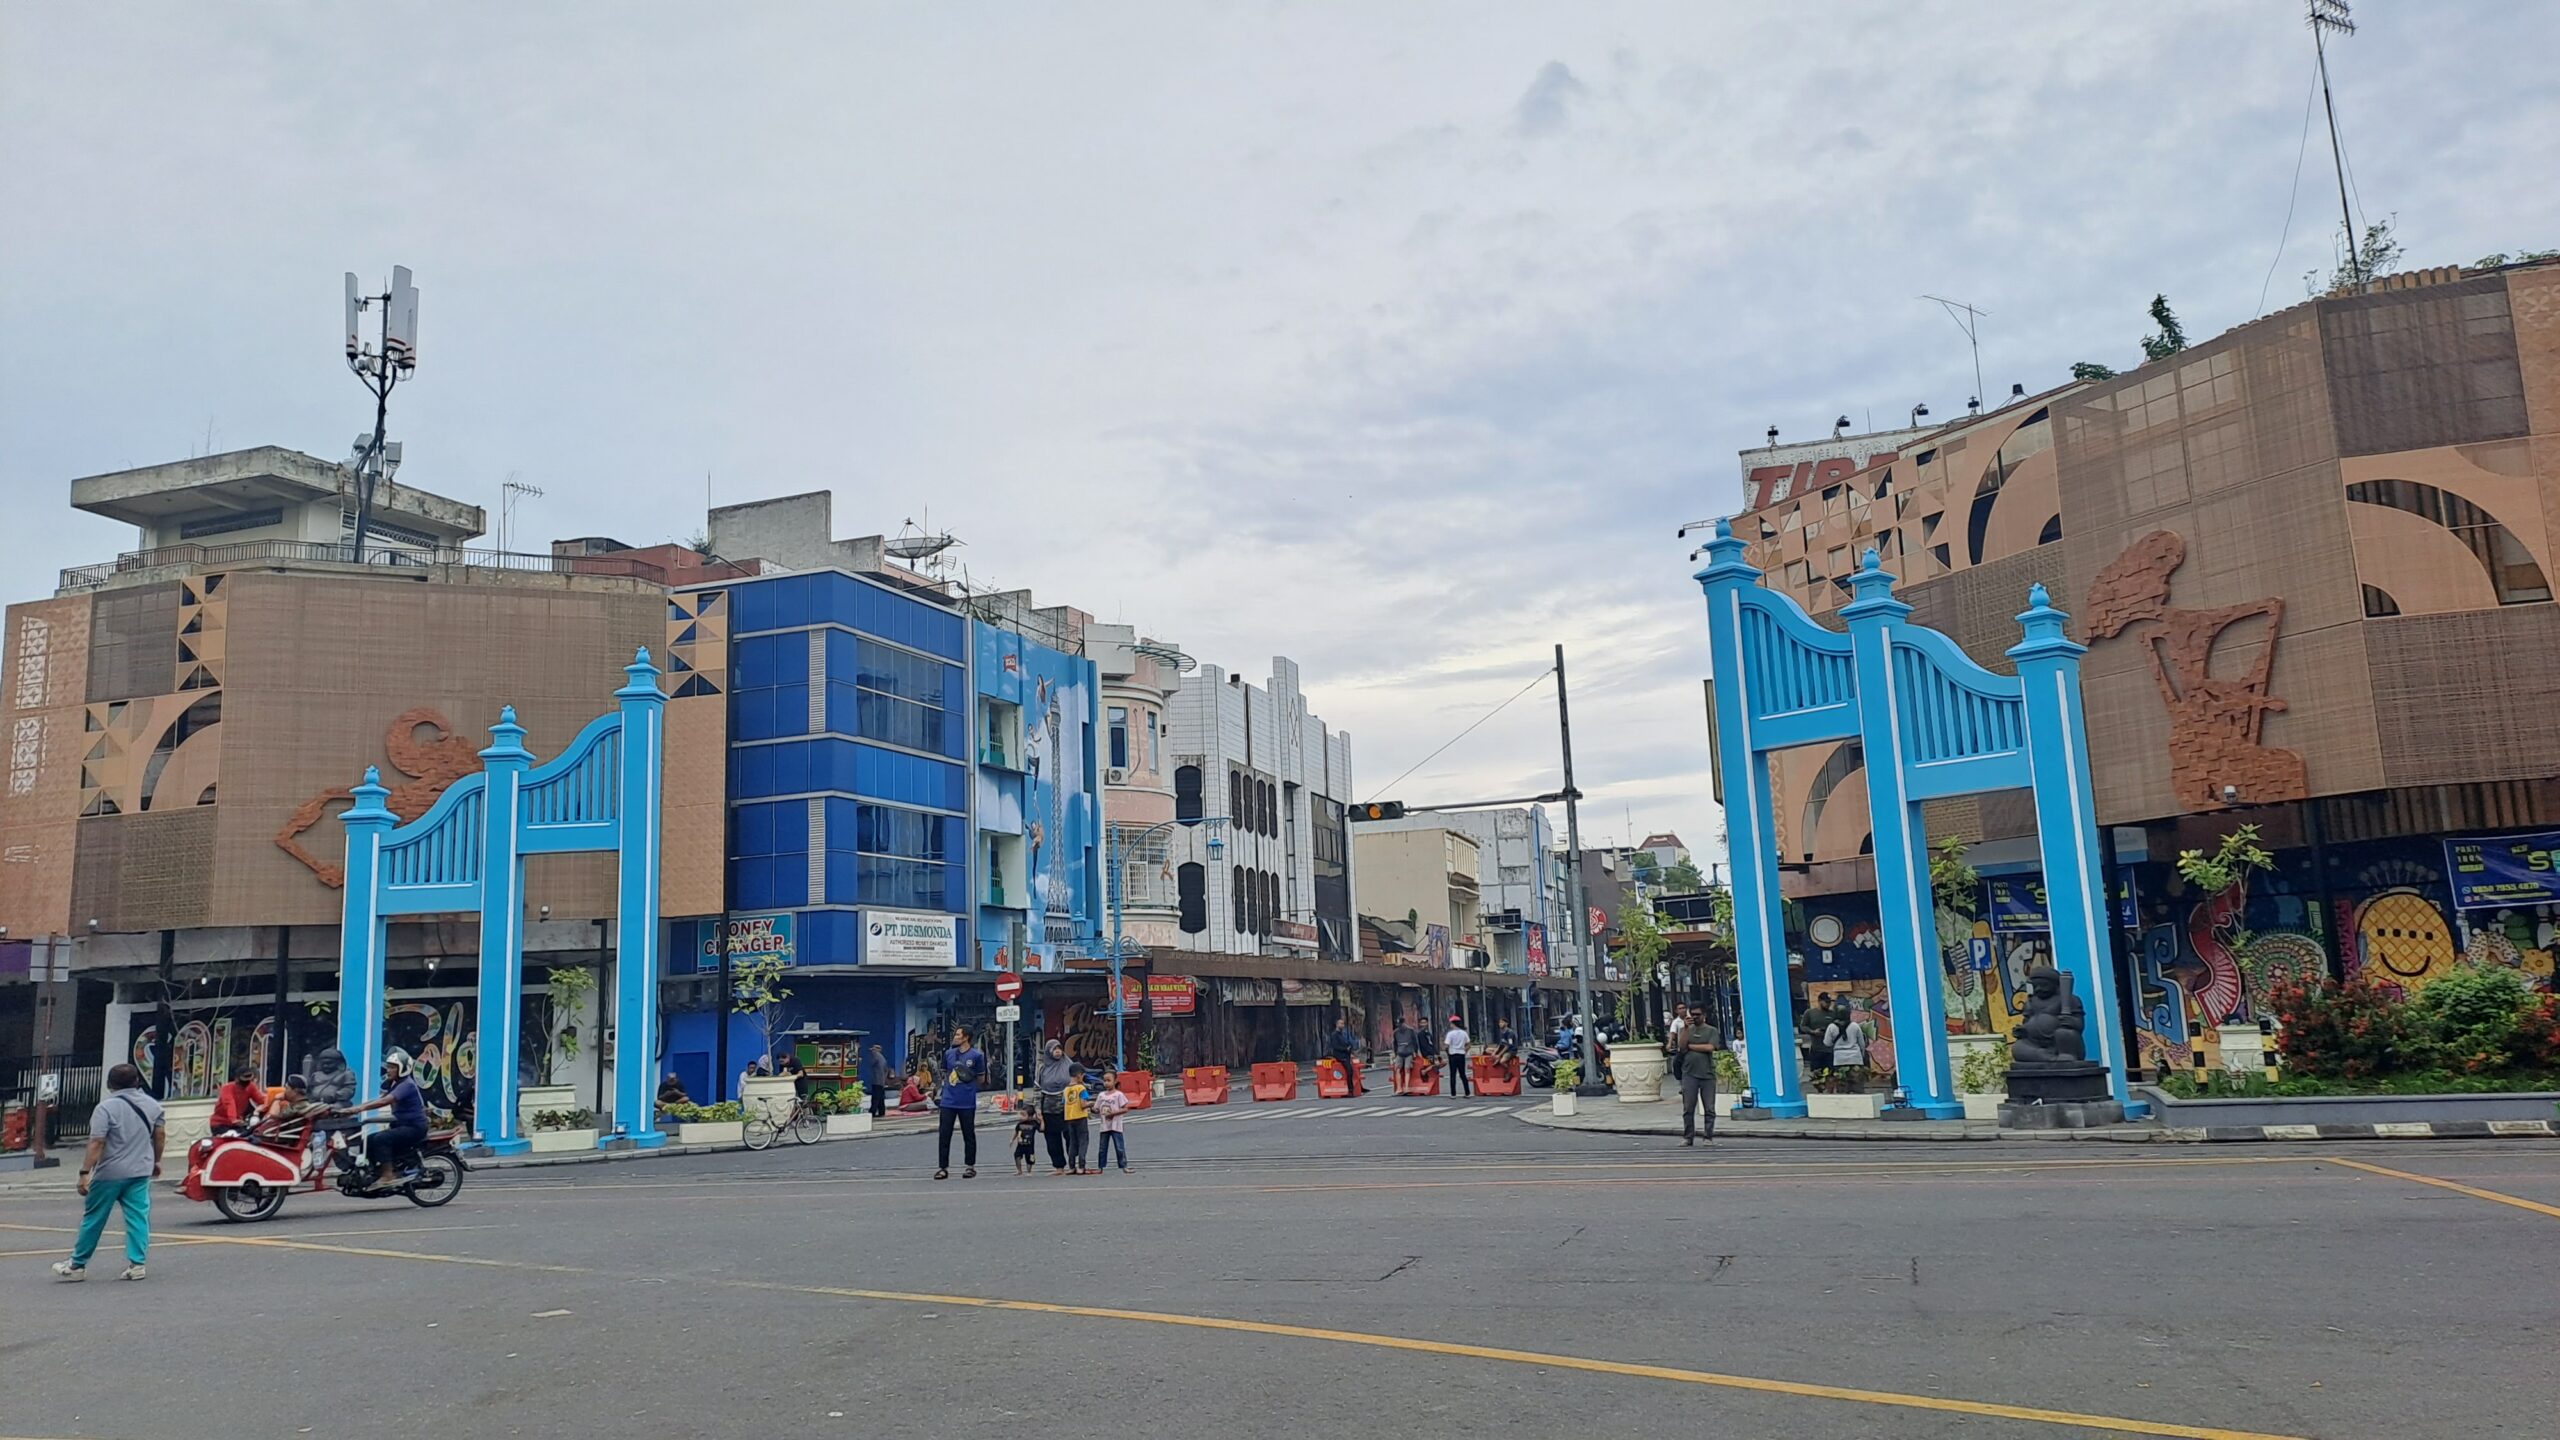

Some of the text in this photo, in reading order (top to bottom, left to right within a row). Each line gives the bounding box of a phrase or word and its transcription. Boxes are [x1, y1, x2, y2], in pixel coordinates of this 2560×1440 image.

[884, 923, 952, 939] PT. DESMONDA
[1973, 939, 1986, 969] P
[1234, 981, 1255, 1001] LIMA
